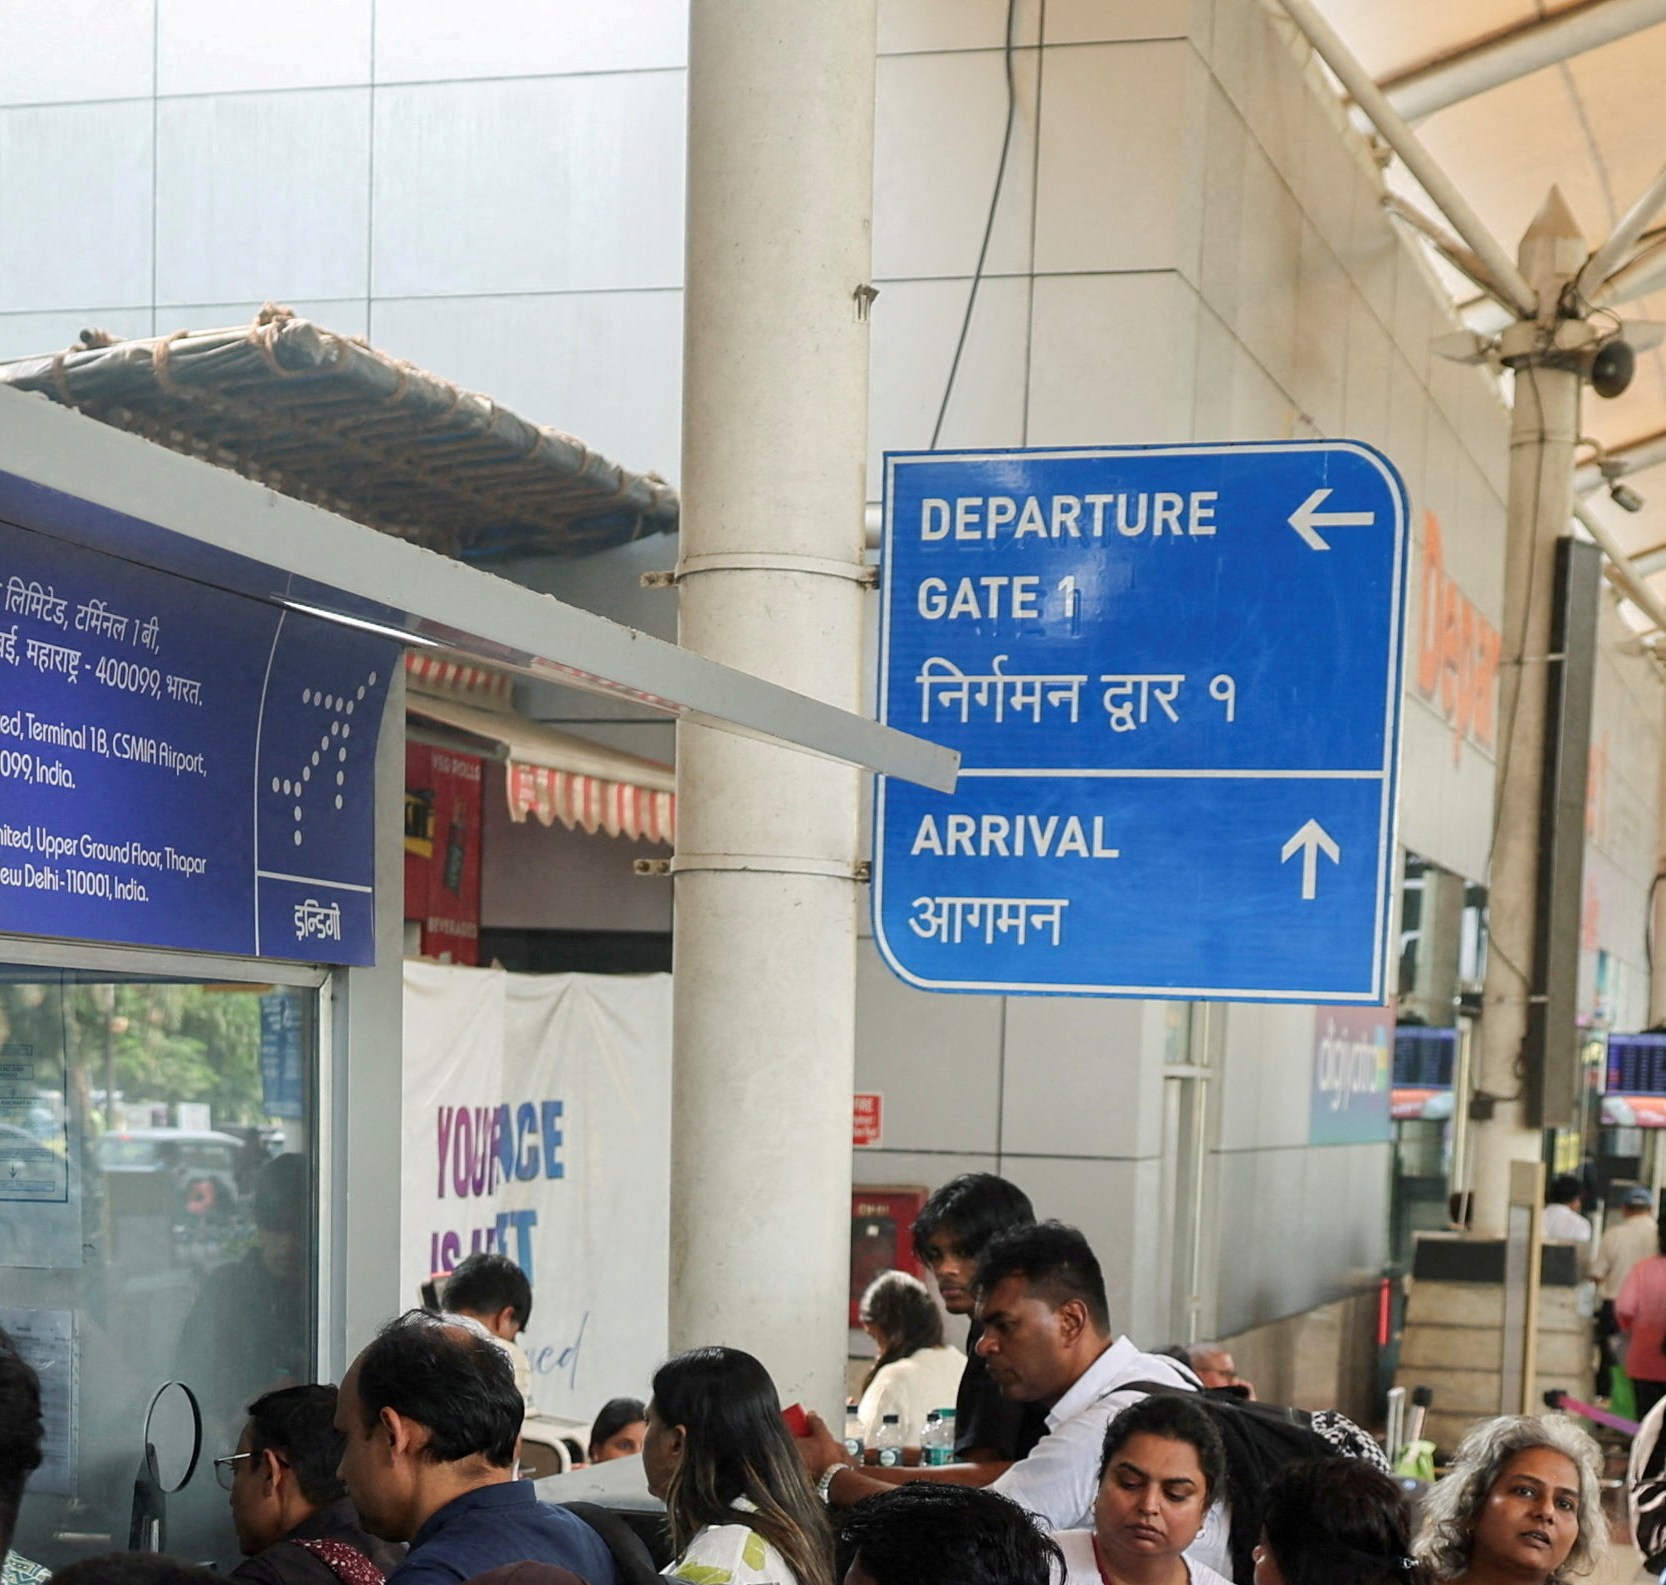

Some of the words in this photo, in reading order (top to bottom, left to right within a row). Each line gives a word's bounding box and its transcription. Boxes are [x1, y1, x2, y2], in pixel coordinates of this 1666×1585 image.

[920, 491, 1218, 541] DEPARTURE
[917, 576, 1039, 620] GATE
[1057, 575, 1077, 618] 1
[27, 638, 81, 684] महाराष्ट्र
[95, 656, 162, 700] 400099,
[166, 674, 202, 706] भारत.
[915, 655, 1087, 723] निर्गमन
[1101, 674, 1185, 732] द्वार
[1209, 674, 1236, 723] १
[26, 712, 85, 750] Terminal
[90, 726, 110, 758] 1B,
[112, 731, 157, 765] CSMIA
[159, 740, 207, 777] Airport,
[36, 760, 76, 789] India.
[36, 827, 78, 860] Upper
[80, 834, 130, 866] Ground
[131, 843, 163, 872] Floor,
[164, 846, 207, 878] Thapar
[910, 815, 1120, 858] ARRIVAL
[114, 876, 149, 902] India.
[908, 896, 1070, 946] आगमन
